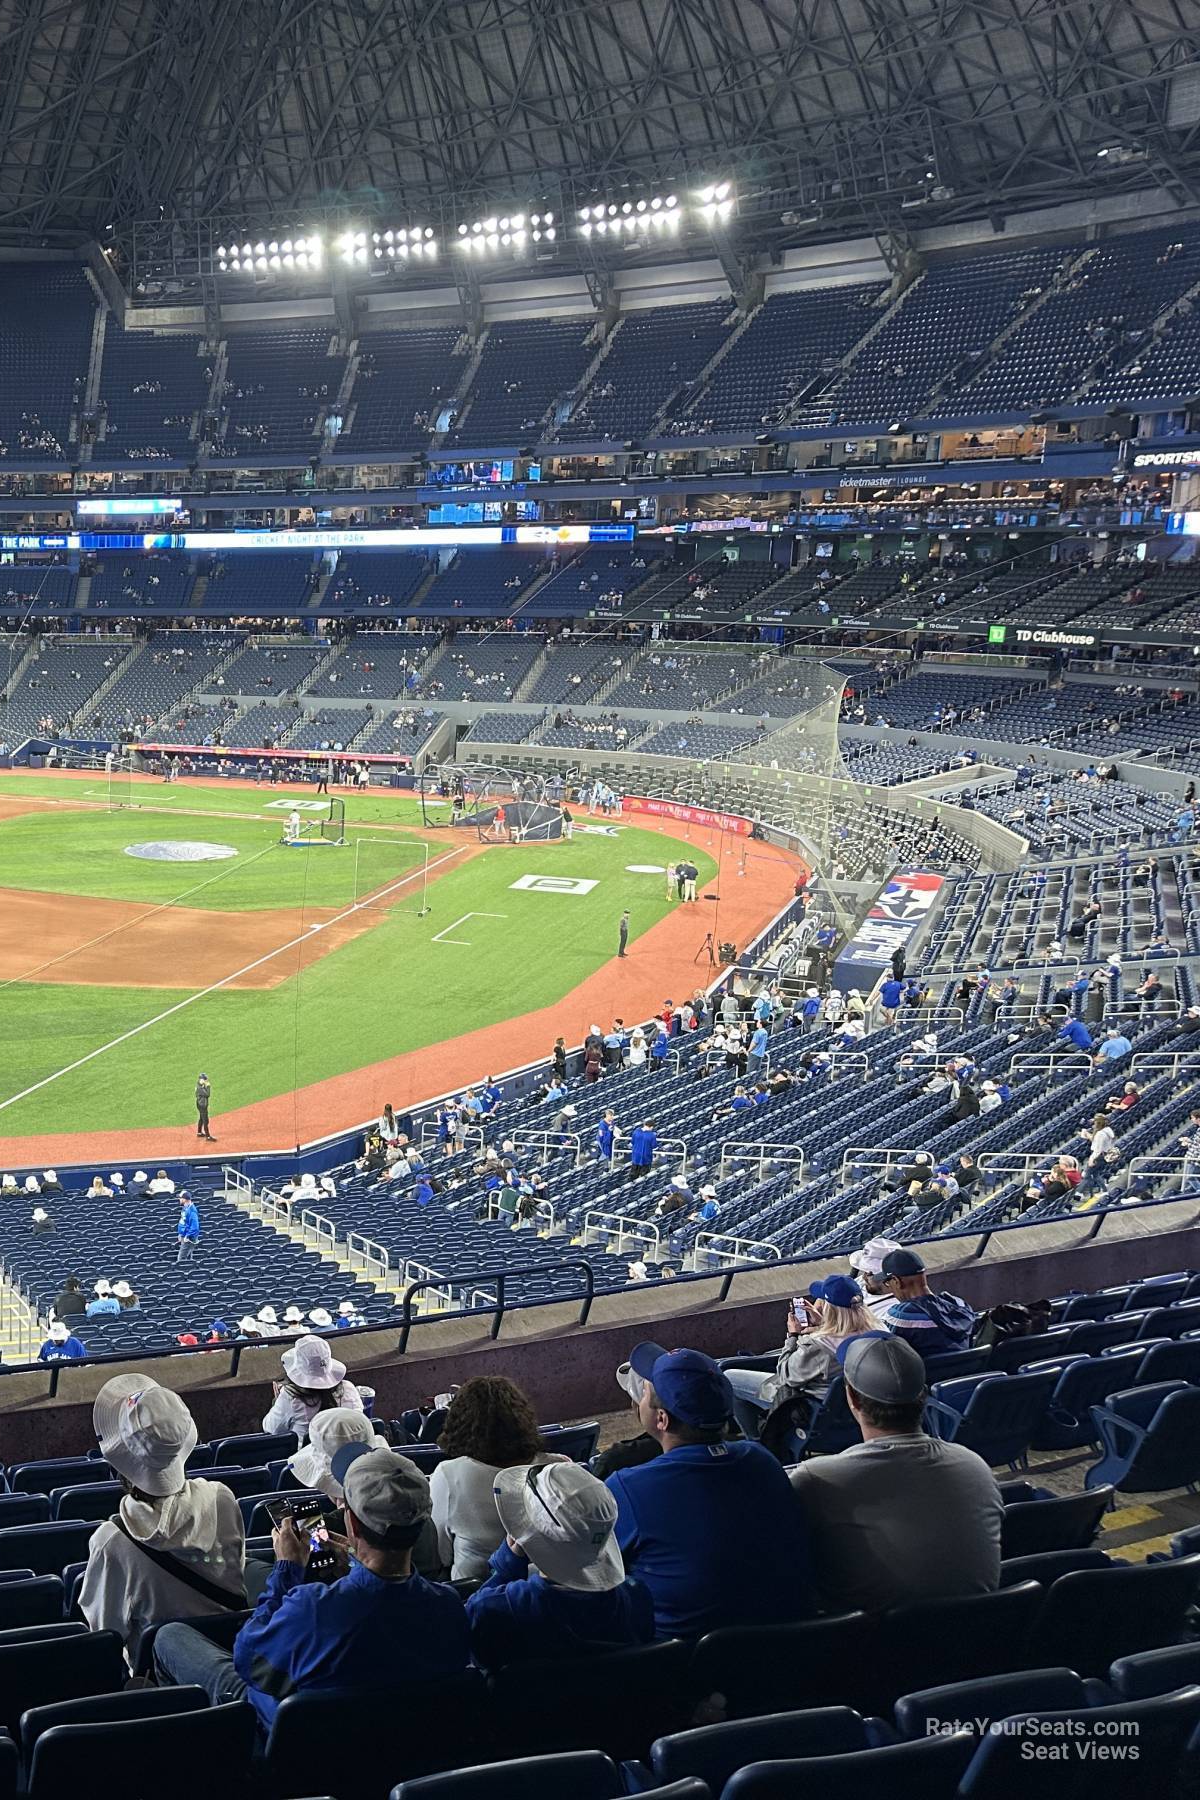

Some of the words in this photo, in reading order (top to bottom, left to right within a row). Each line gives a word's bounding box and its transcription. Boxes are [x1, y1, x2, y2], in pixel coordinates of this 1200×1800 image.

[839, 477, 891, 488] ticketmaster
[900, 476, 927, 484] LOUNGE
[3, 537, 19, 548] THE
[20, 537, 40, 548] PARK
[251, 535, 285, 545] CRICKET
[287, 535, 312, 545] NIGHT
[314, 534, 324, 544] AT
[326, 534, 341, 544] THE
[343, 534, 366, 543] PARK
[1016, 630, 1031, 641] TD
[1032, 632, 1095, 645] Clubhouse
